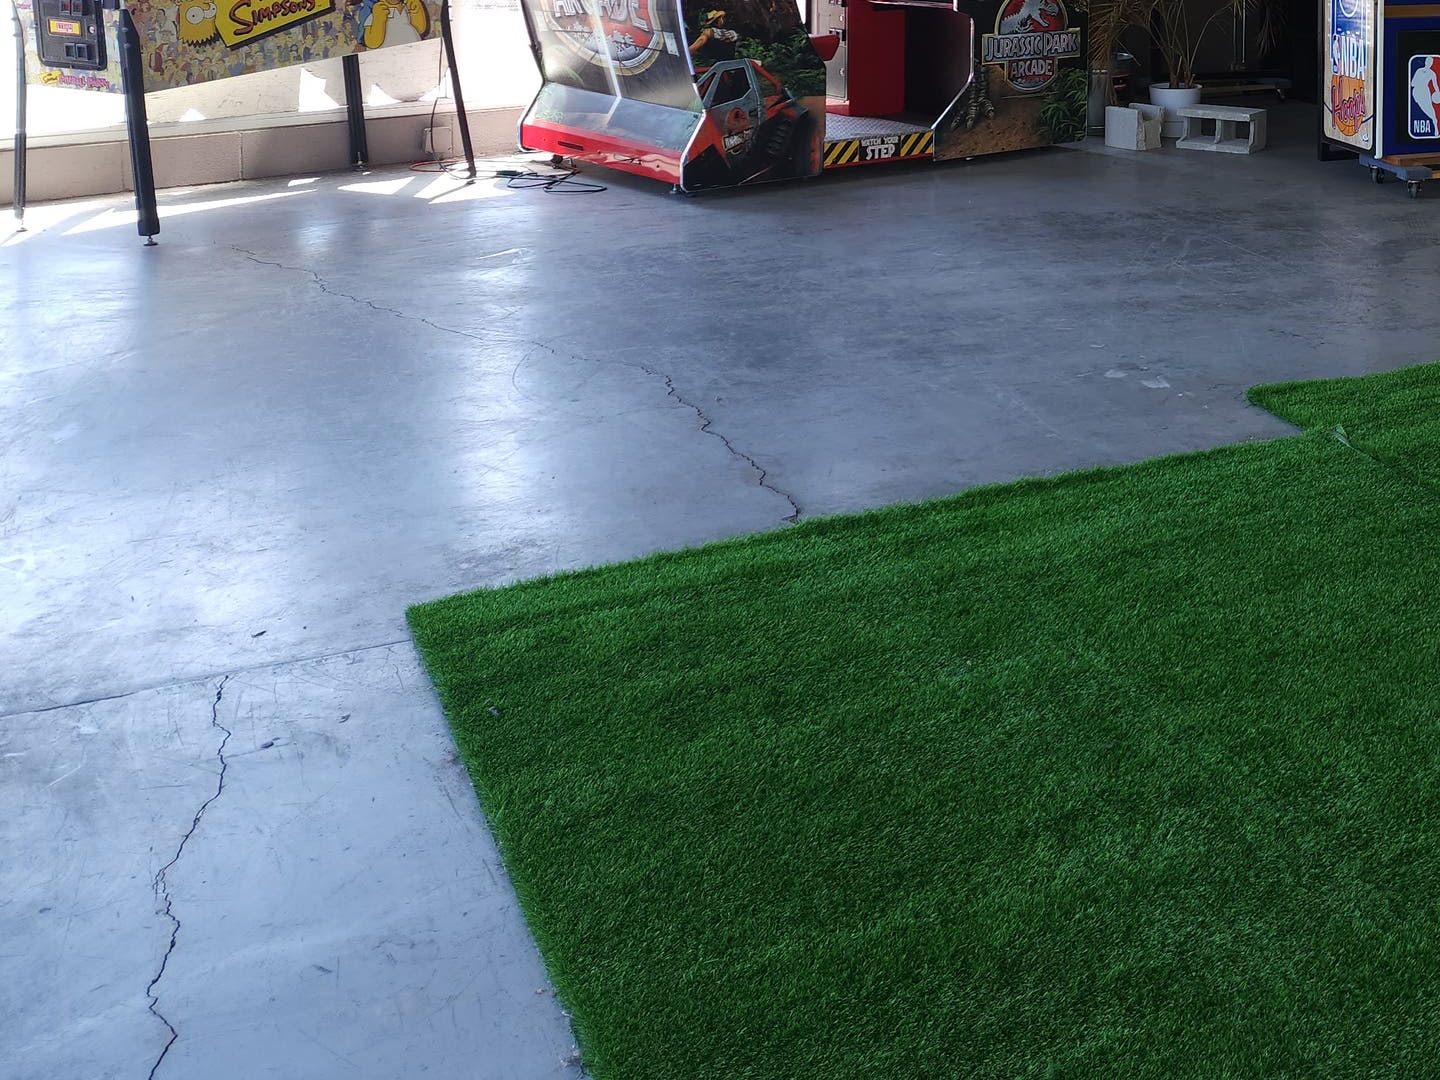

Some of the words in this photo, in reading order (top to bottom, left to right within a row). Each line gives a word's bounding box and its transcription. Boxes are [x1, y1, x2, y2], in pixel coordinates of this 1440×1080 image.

[985, 37, 1041, 62] JURASSIC
[1044, 32, 1078, 57] PARK
[1341, 34, 1366, 81] NBA
[1010, 59, 1054, 78] ARCADE
[1413, 120, 1431, 134] NBA
[861, 137, 882, 147] WATCH
[883, 135, 899, 145] YOUR
[866, 143, 895, 160] STEP
